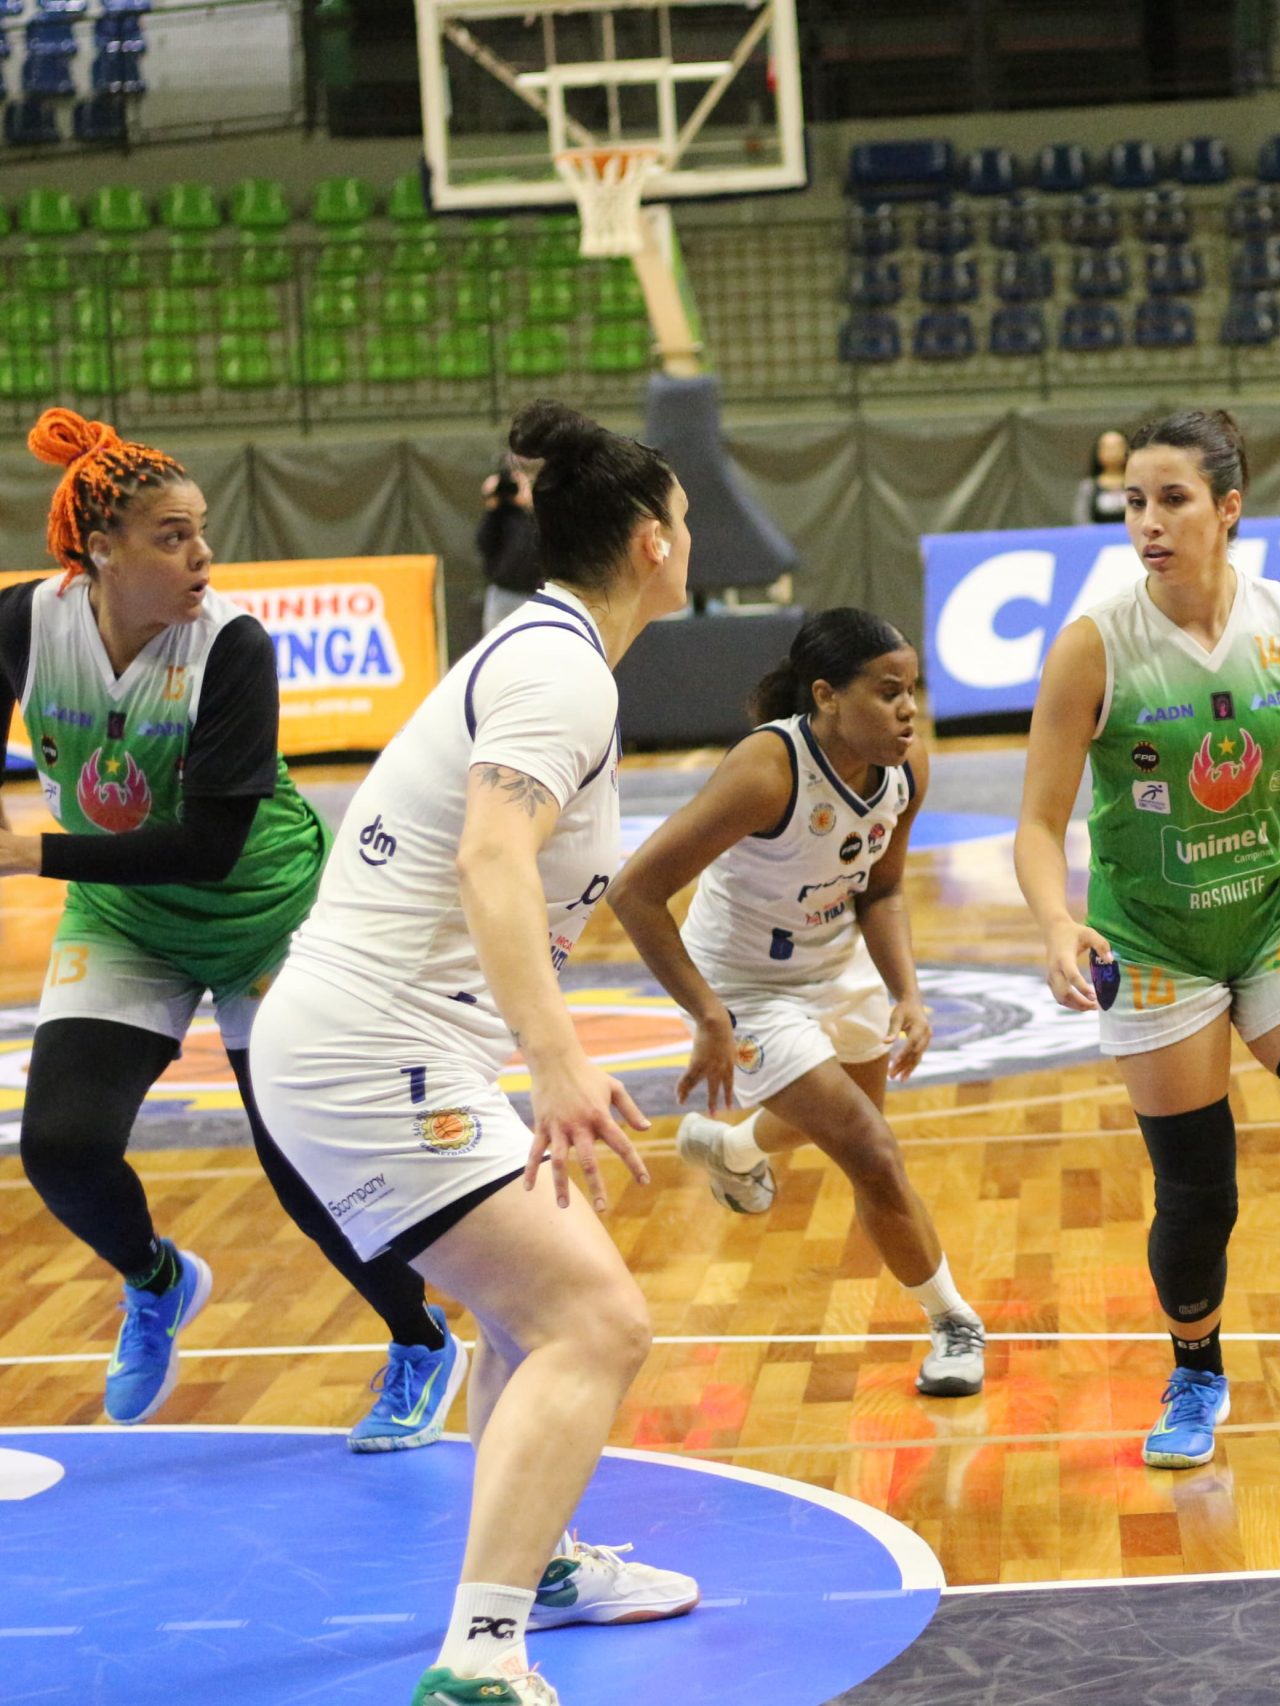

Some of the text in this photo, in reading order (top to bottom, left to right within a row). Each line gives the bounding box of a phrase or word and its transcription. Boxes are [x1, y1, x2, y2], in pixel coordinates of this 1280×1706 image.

[1156, 704, 1195, 722] ADN
[50, 946, 90, 986] 13
[1126, 964, 1177, 1012] 14
[401, 1066, 427, 1104] 1
